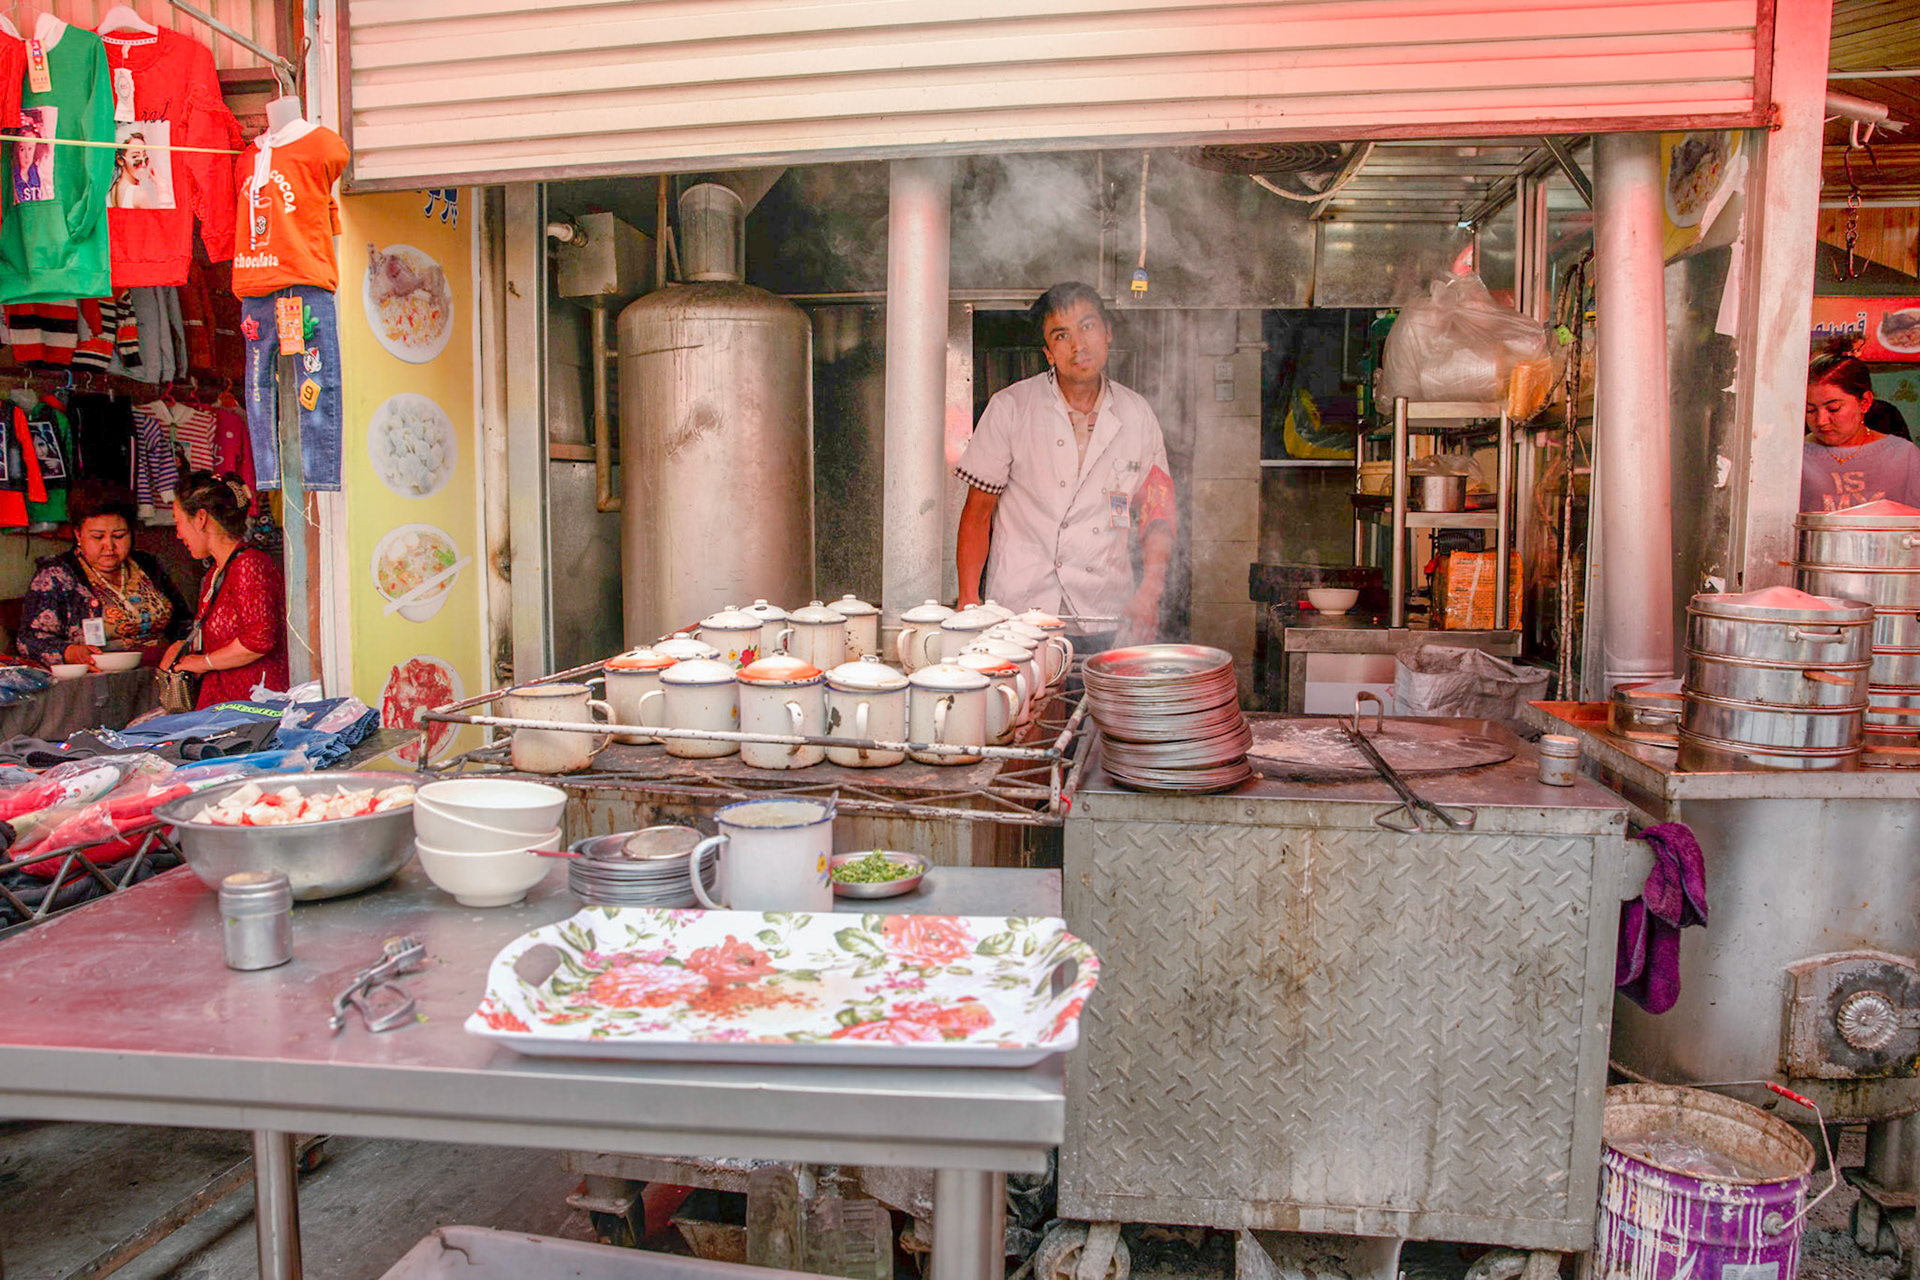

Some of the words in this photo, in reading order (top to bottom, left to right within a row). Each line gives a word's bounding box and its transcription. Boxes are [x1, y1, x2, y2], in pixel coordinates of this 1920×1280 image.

[269, 169, 297, 214] COCOA
[1831, 471, 1866, 494] IS
[1823, 490, 1886, 512] MY
